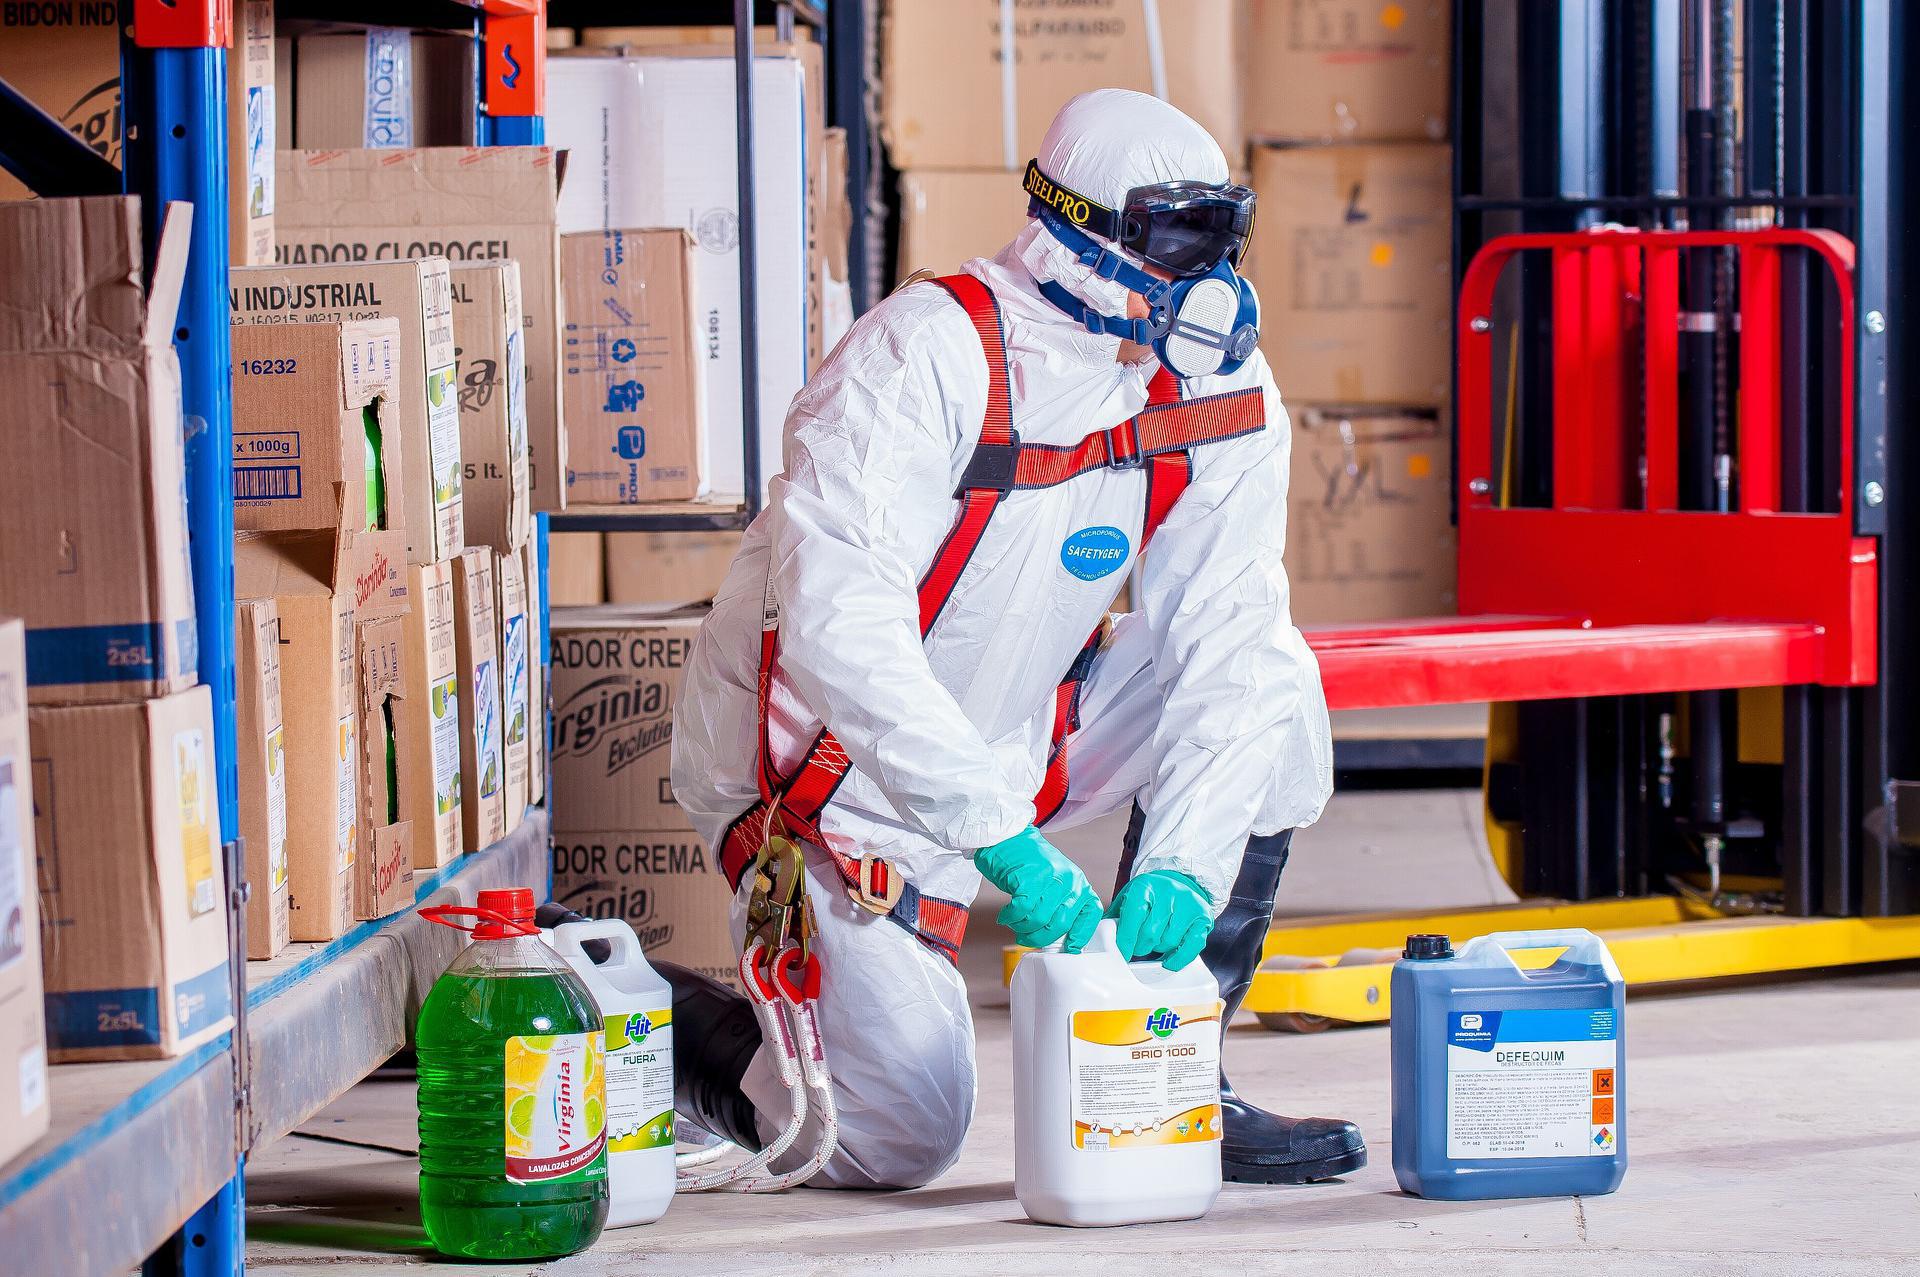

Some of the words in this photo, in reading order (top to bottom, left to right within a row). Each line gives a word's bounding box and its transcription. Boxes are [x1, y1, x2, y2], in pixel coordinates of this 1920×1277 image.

[4, 1, 73, 26] BIDON
[79, 1, 120, 26] IND
[1027, 166, 1089, 224] STEELPRO
[229, 287, 239, 311] N
[245, 282, 382, 311] INDUSTRIAL
[450, 283, 473, 303] AL
[241, 359, 297, 376] 16232
[248, 439, 290, 454] 1000g
[464, 463, 476, 480] 5
[484, 463, 504, 480] lt.
[1067, 545, 1120, 560] SAFETYGEN
[1070, 566, 1109, 579] TECHNOLOGY
[278, 617, 291, 645] L
[107, 648, 153, 667] 2x5L
[551, 638, 622, 669] ADOR
[551, 680, 662, 753] irginia
[607, 721, 673, 770] Evolutio
[553, 845, 608, 875] DOR
[616, 844, 708, 875] CREMA
[288, 894, 301, 910] t.
[585, 886, 648, 920] inia
[640, 925, 669, 945] tion
[97, 1010, 145, 1032] 2x5L
[624, 1017, 652, 1037] Hit
[1146, 1010, 1181, 1031] Hit
[623, 1054, 657, 1065] FUERA
[1131, 1050, 1163, 1060] BRIO
[1166, 1047, 1196, 1057] 1000
[1496, 1051, 1565, 1063] DEFEQUIM
[558, 1061, 575, 1152] Virginia
[528, 1160, 570, 1173] LAVALOZAS
